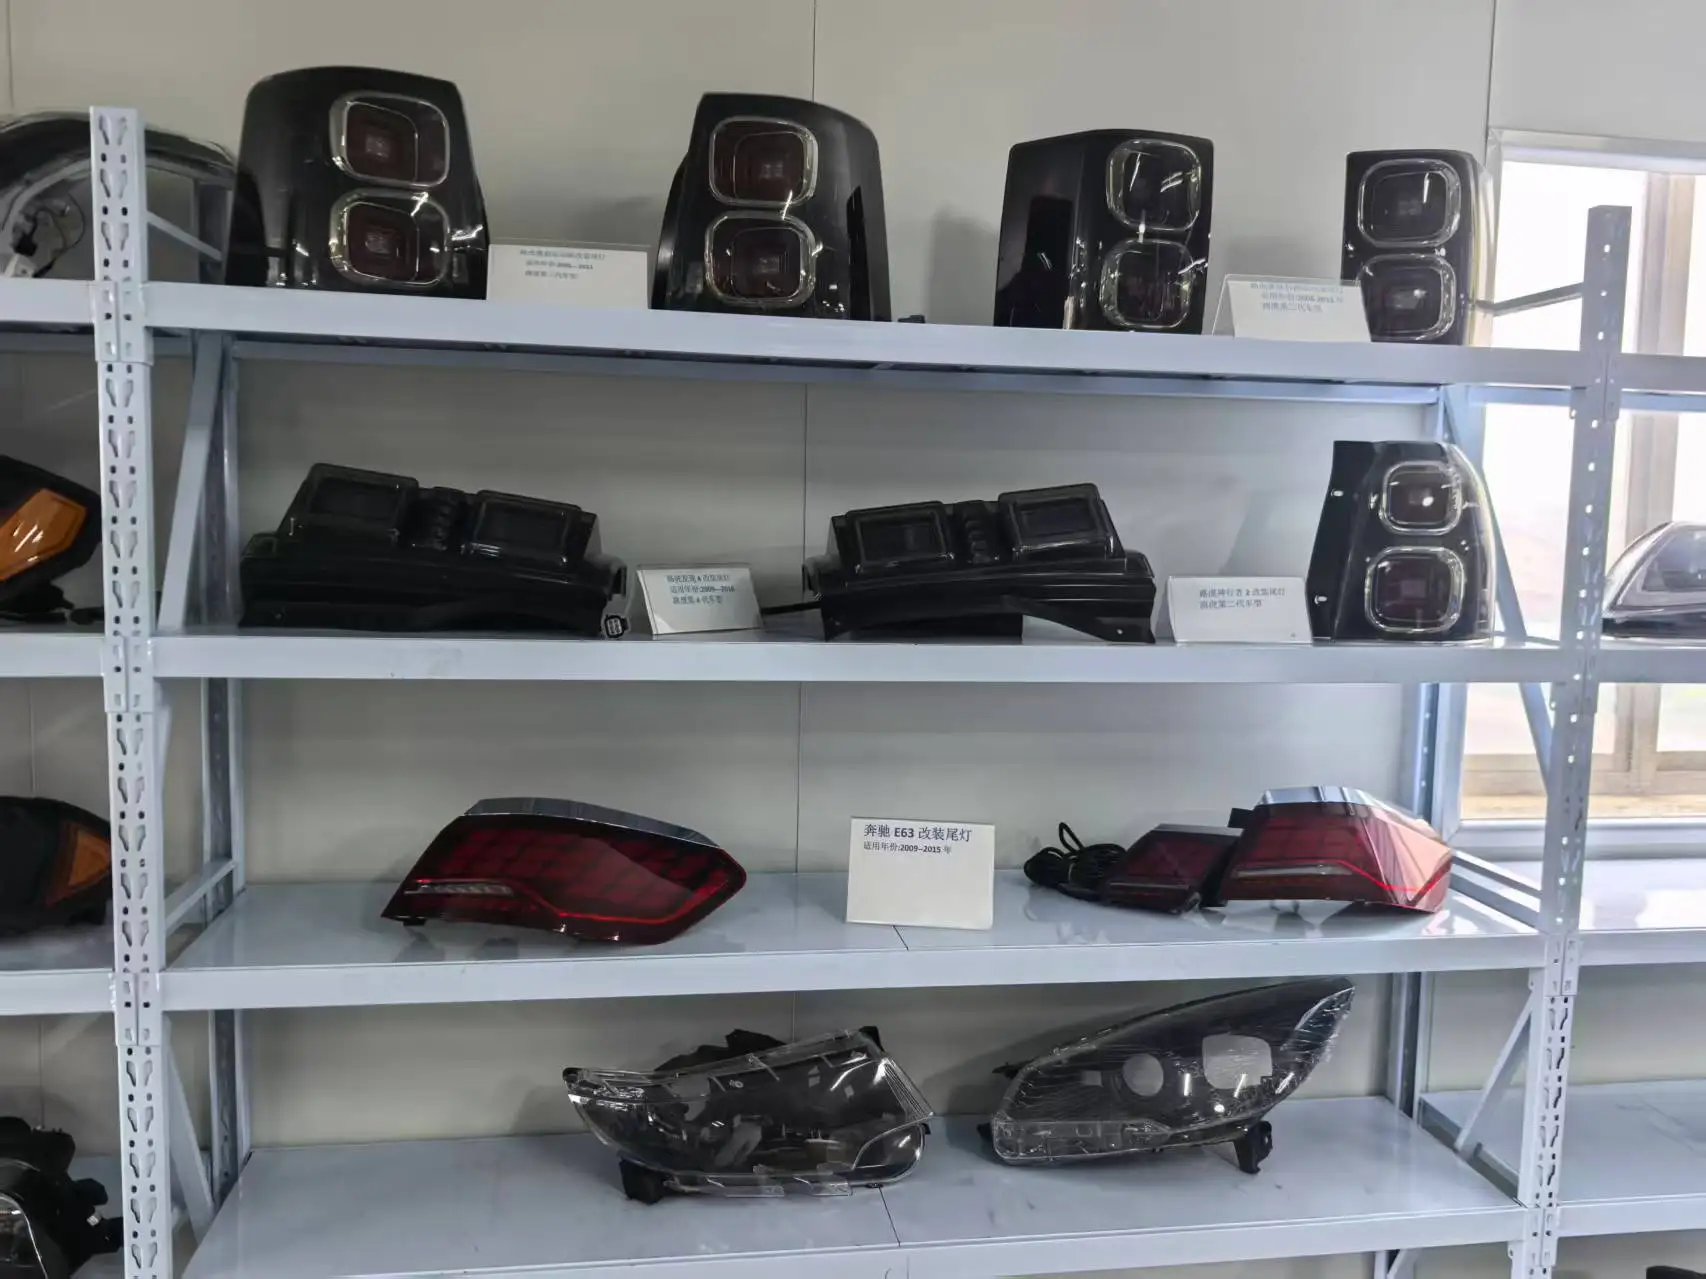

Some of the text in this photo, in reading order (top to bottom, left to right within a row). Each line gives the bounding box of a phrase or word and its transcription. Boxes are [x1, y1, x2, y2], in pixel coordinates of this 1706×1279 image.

[864, 824, 972, 842] 奔驰 E63 改装尾灯
